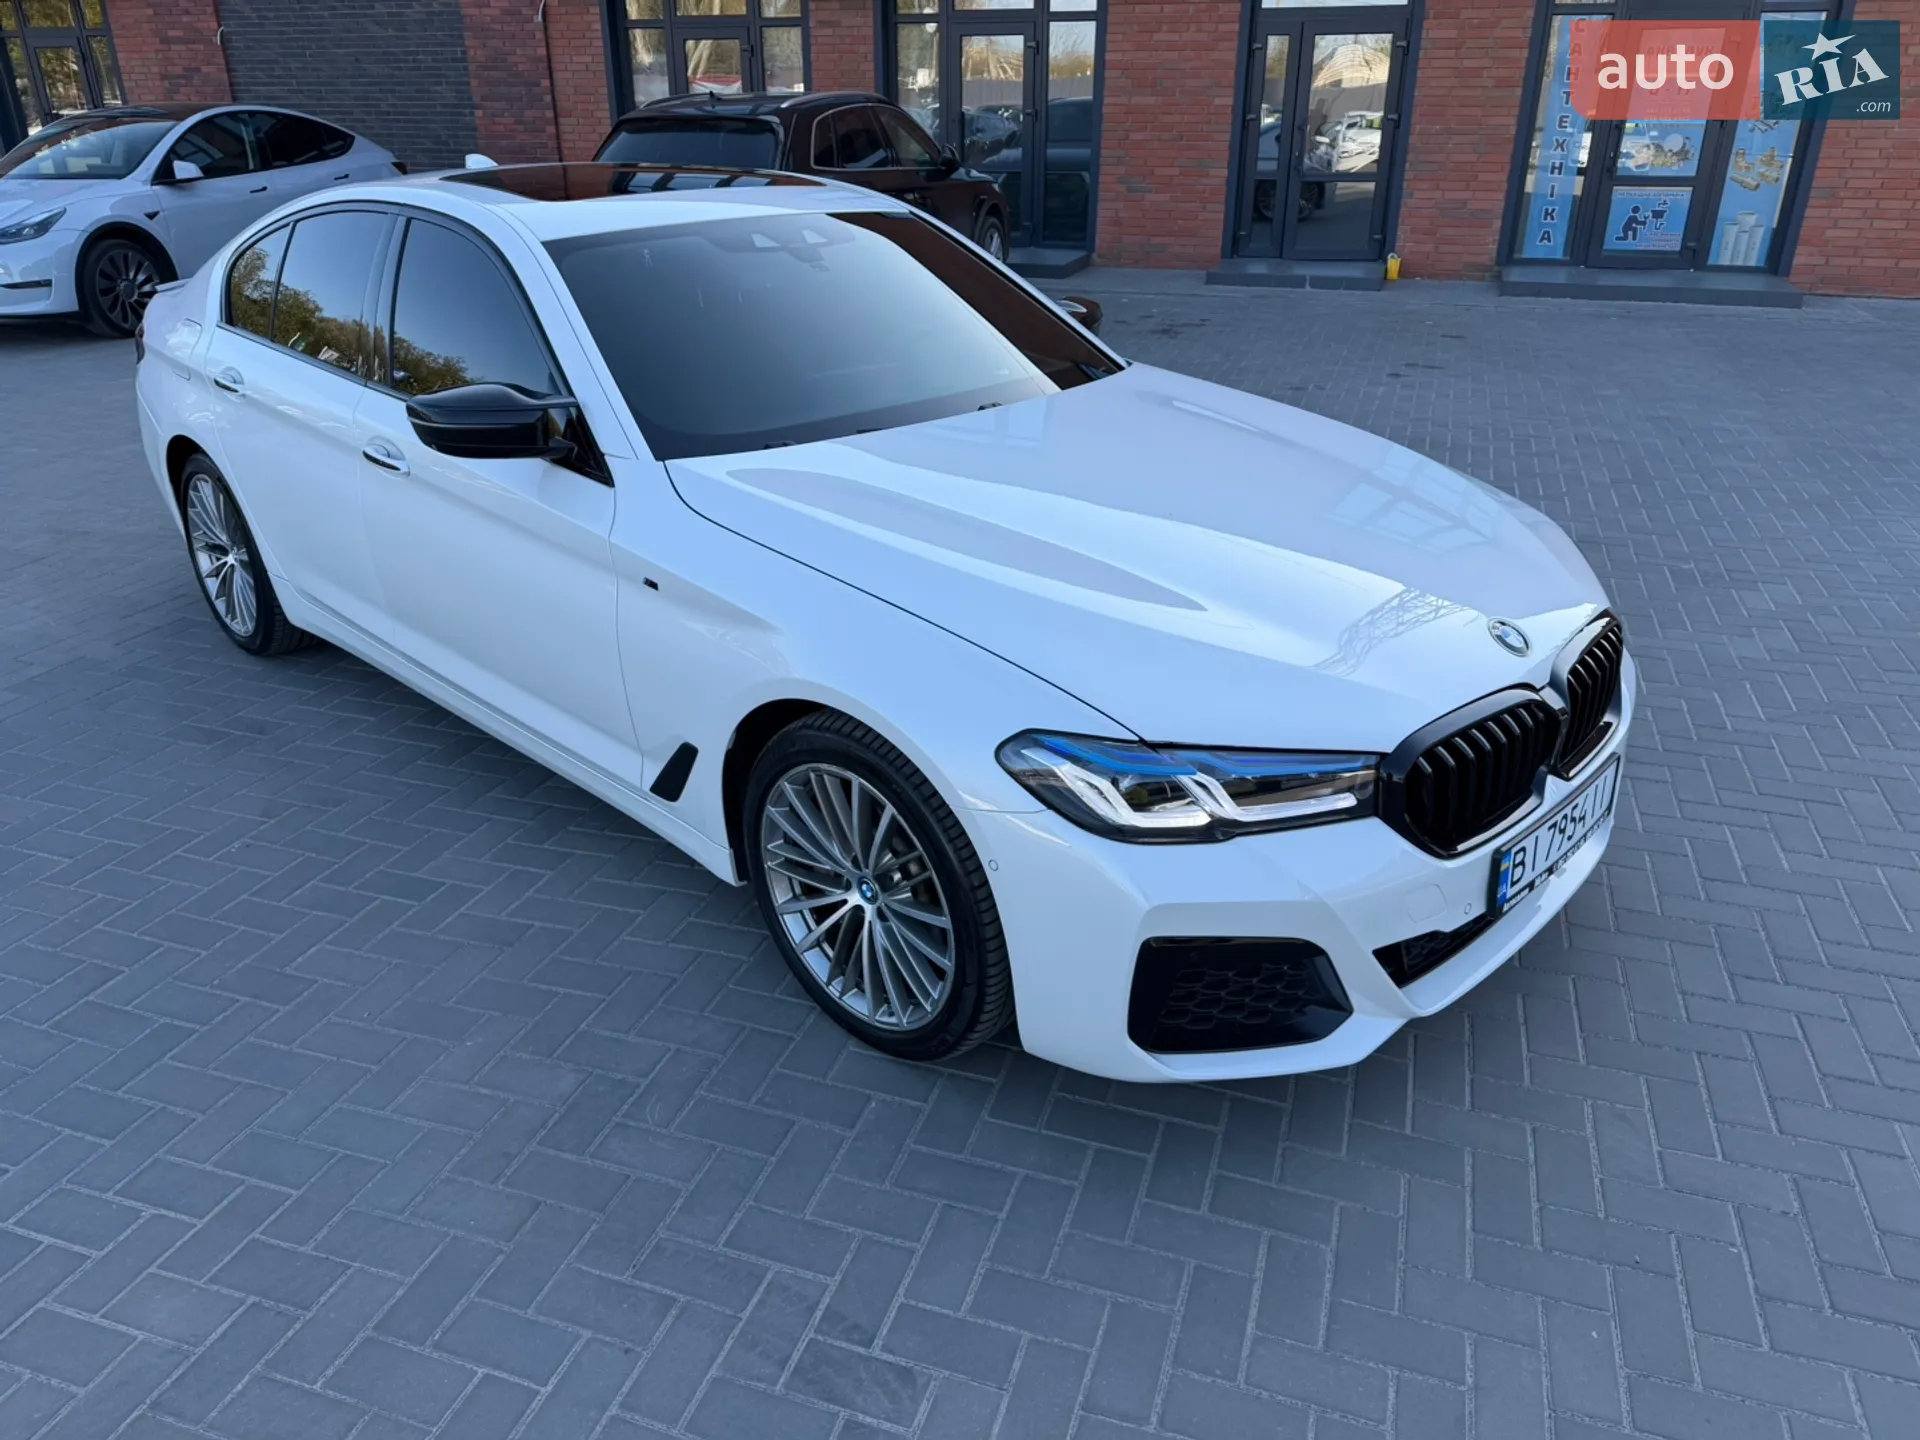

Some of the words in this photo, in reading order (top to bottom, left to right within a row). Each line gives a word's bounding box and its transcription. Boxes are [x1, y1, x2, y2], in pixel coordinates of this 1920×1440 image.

[1537, 17, 1588, 245] САНТЕХНІКА
[1510, 836, 1539, 889] BI
[1545, 793, 1589, 862] 7954
